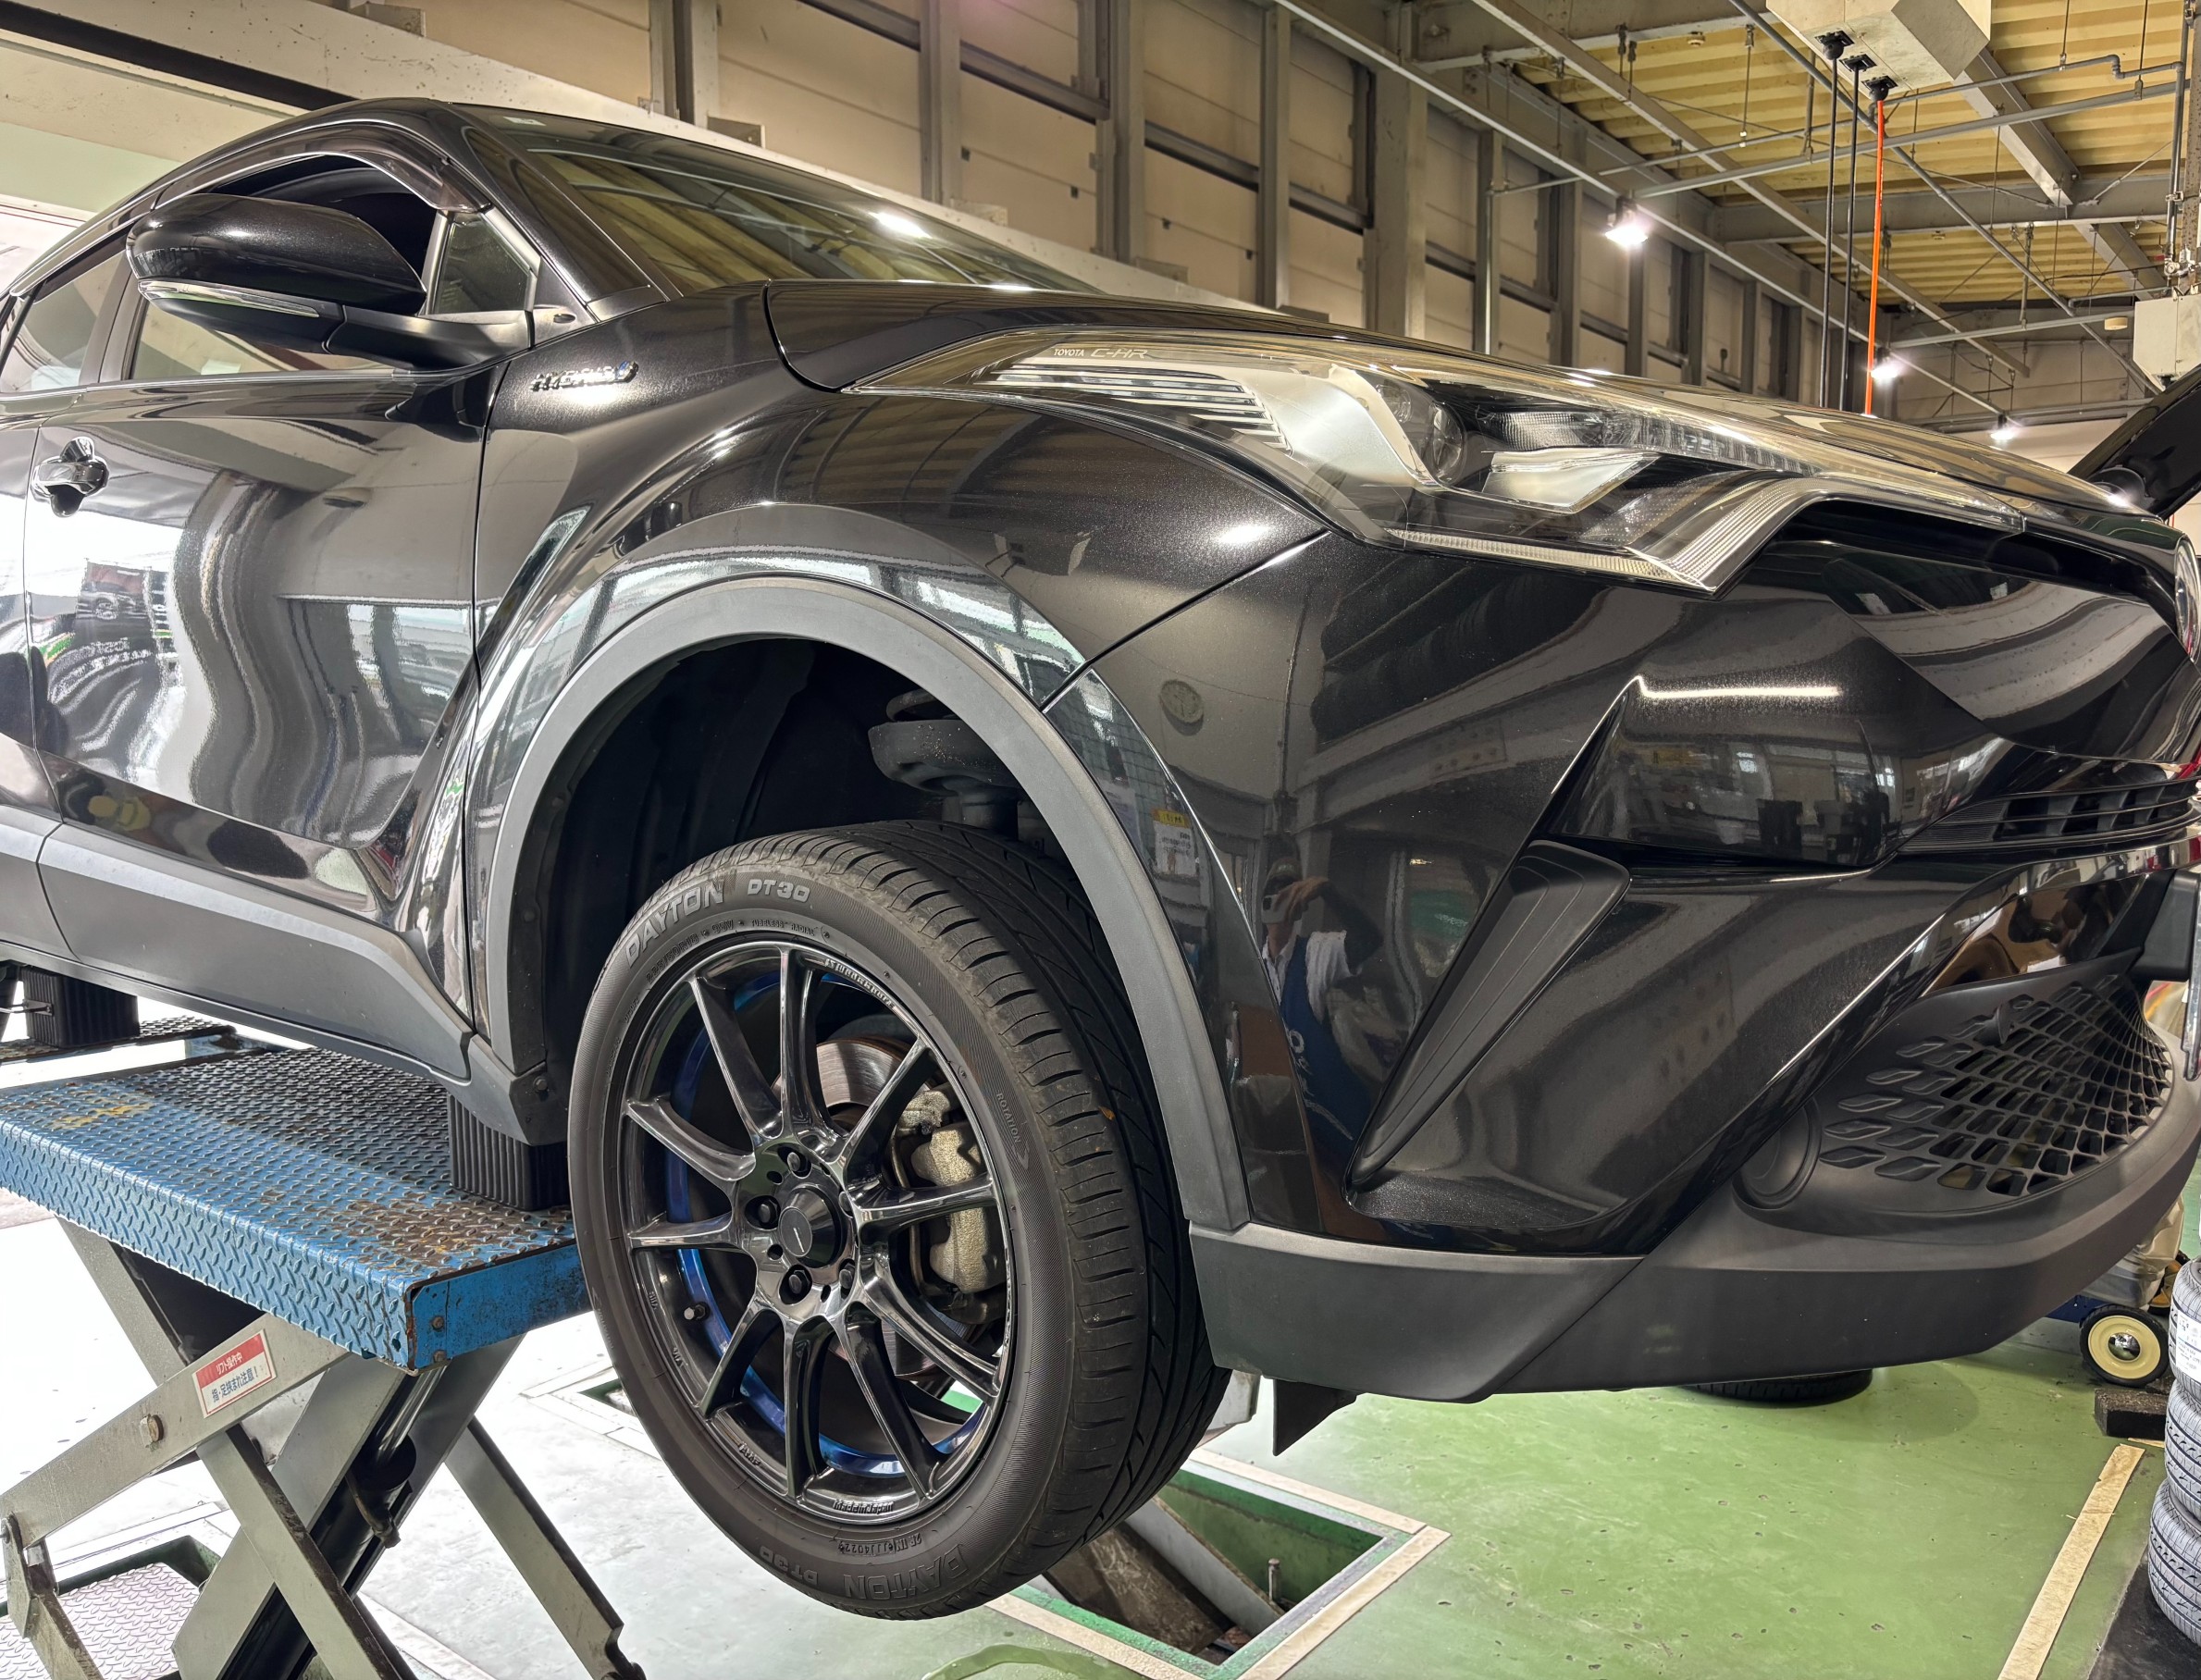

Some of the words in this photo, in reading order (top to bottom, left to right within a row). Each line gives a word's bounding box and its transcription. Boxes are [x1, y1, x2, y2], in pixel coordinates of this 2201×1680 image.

[1054, 348, 1084, 357] TOYOTA
[1091, 348, 1148, 359] C-HR
[625, 879, 724, 970] DAYTON
[748, 879, 810, 903] DT30
[751, 919, 785, 929] TUBELESS
[791, 923, 815, 936] RADIAL
[996, 1093, 1021, 1143] ROTATION
[216, 1352, 243, 1376] リフト操作中
[759, 1545, 818, 1586] DT30
[843, 1543, 970, 1600] DAYTON
